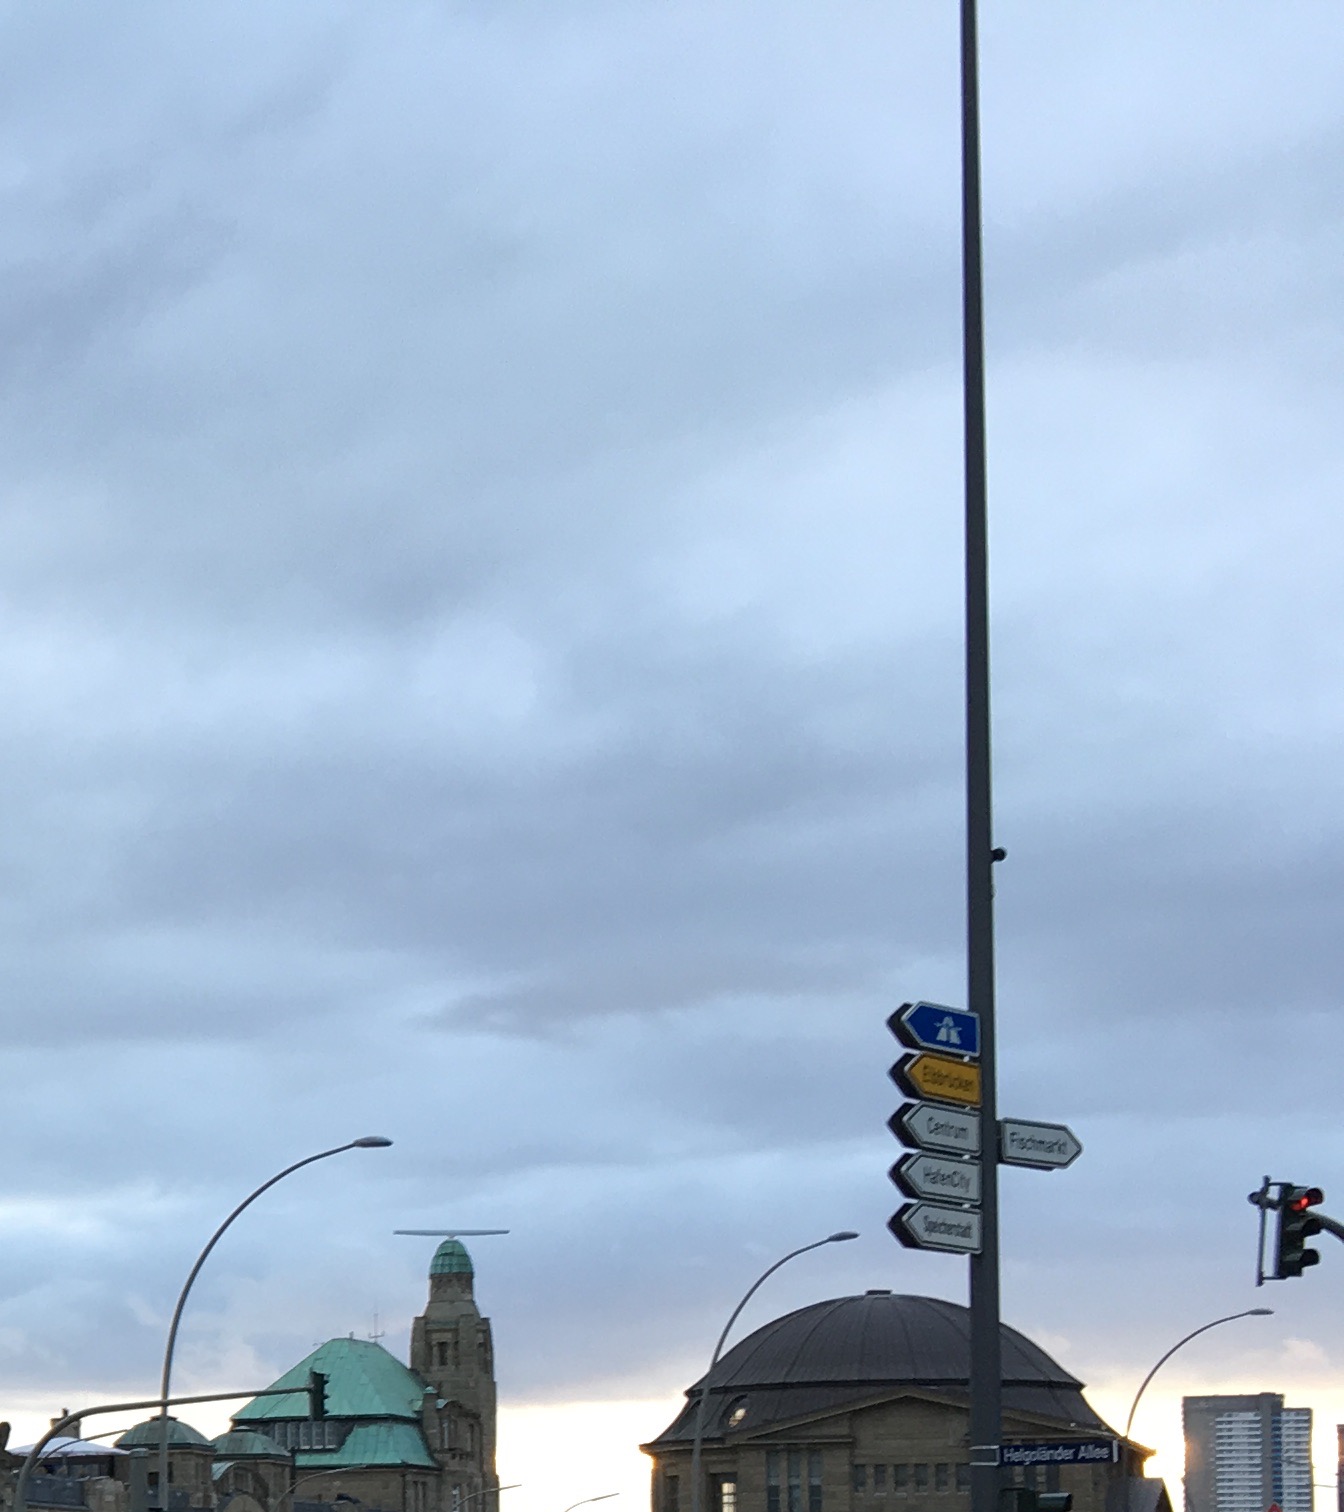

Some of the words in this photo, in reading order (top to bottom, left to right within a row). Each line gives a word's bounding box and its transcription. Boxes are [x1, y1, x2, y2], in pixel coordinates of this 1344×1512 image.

[927, 1116, 969, 1140] Centrum
[1004, 1446, 1075, 1466] Helgoländer
[1077, 1444, 1110, 1460] Allee
